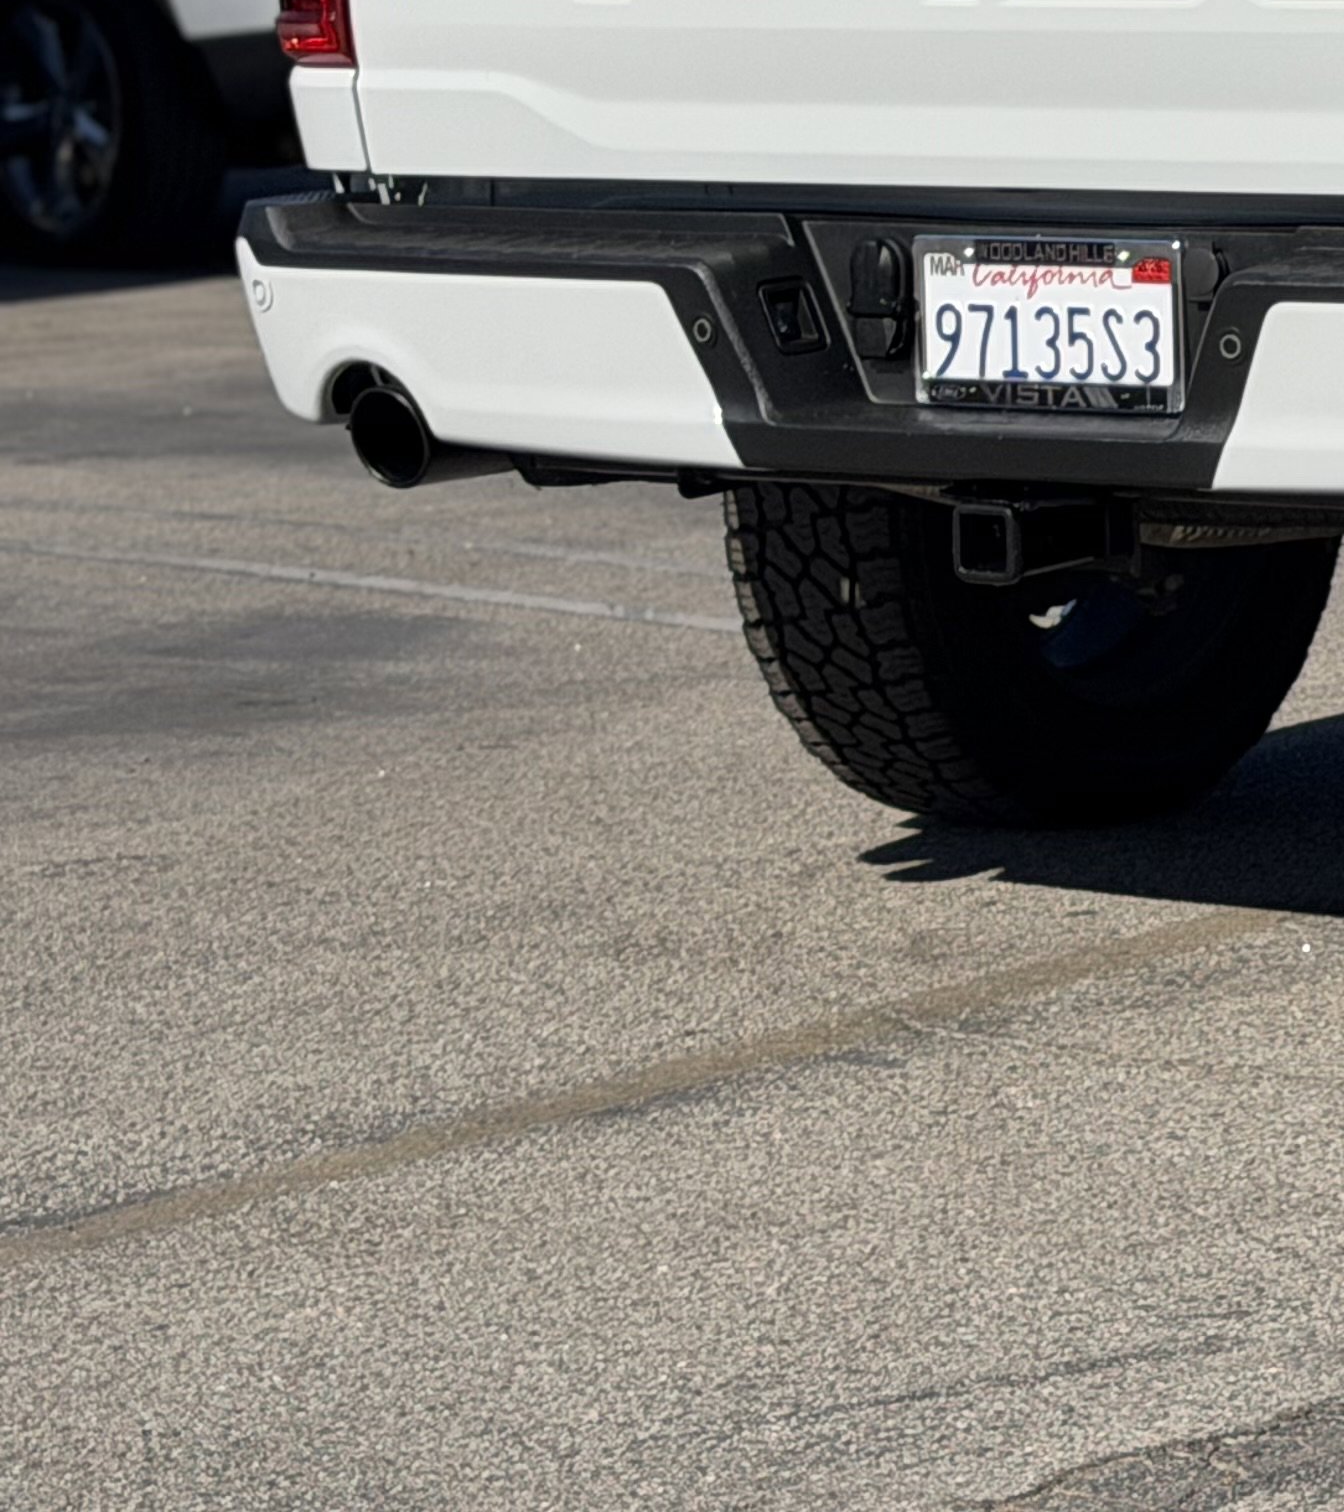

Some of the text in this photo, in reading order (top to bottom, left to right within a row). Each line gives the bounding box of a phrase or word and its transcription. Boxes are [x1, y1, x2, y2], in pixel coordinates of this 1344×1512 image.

[972, 263, 1133, 300] California
[935, 303, 1161, 383] 97135S3
[981, 384, 1088, 409] VISTA
